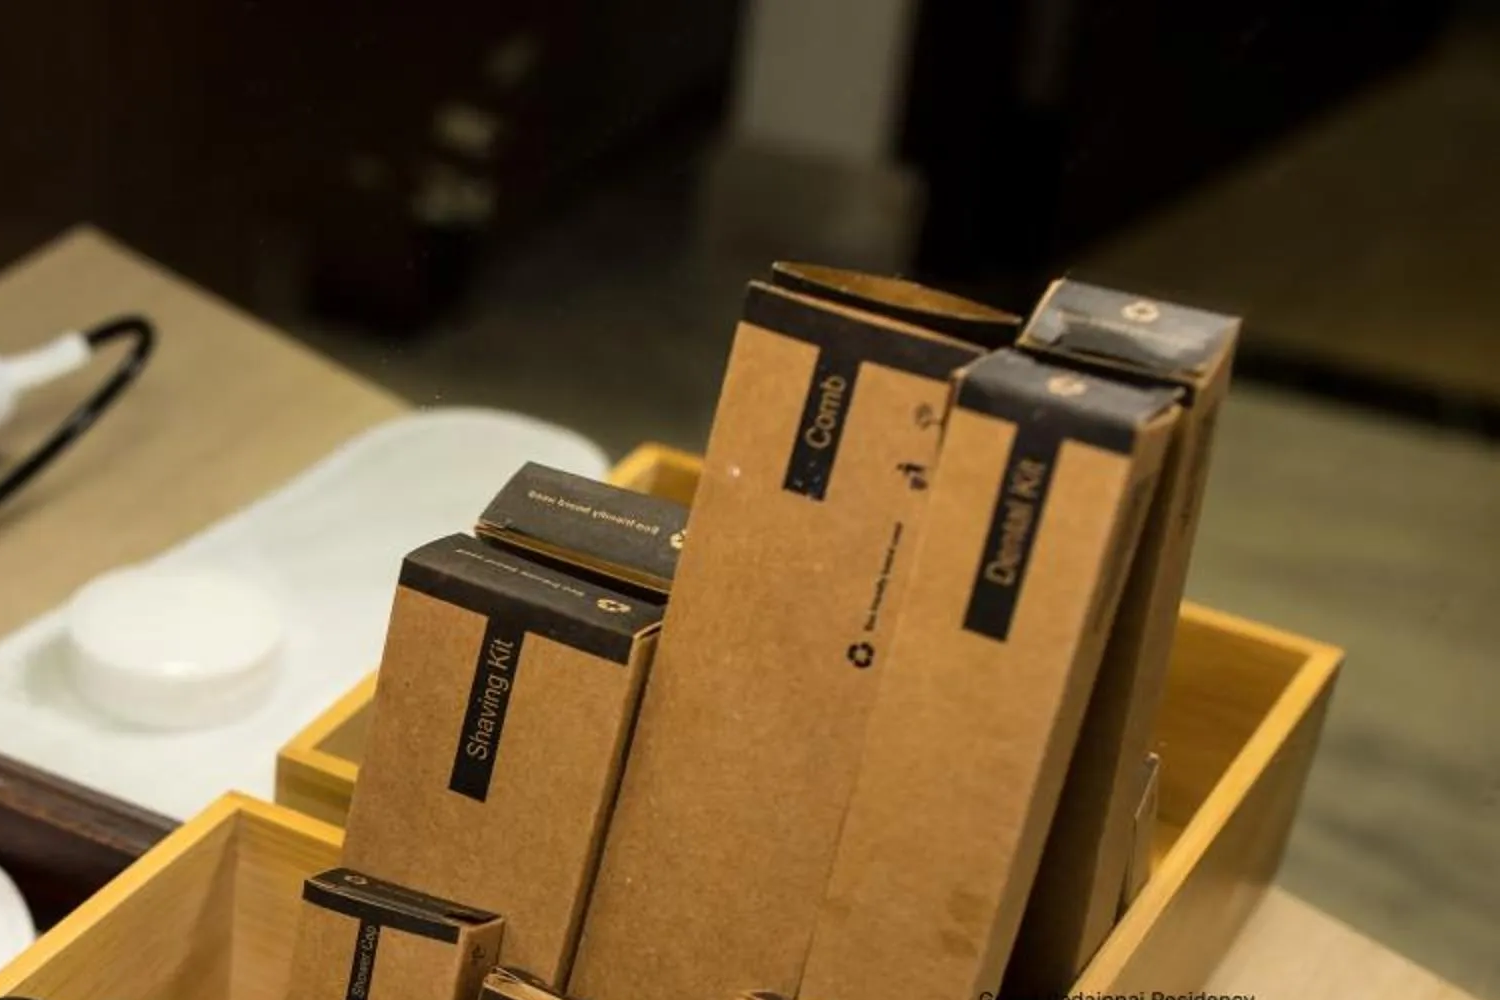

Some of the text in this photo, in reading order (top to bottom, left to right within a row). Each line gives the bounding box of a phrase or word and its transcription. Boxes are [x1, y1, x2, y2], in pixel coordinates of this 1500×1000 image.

[805, 375, 847, 450] Comb
[984, 500, 1033, 586] Dental
[466, 638, 514, 760] Shaving Kit
[351, 925, 377, 998] Shower Cap
